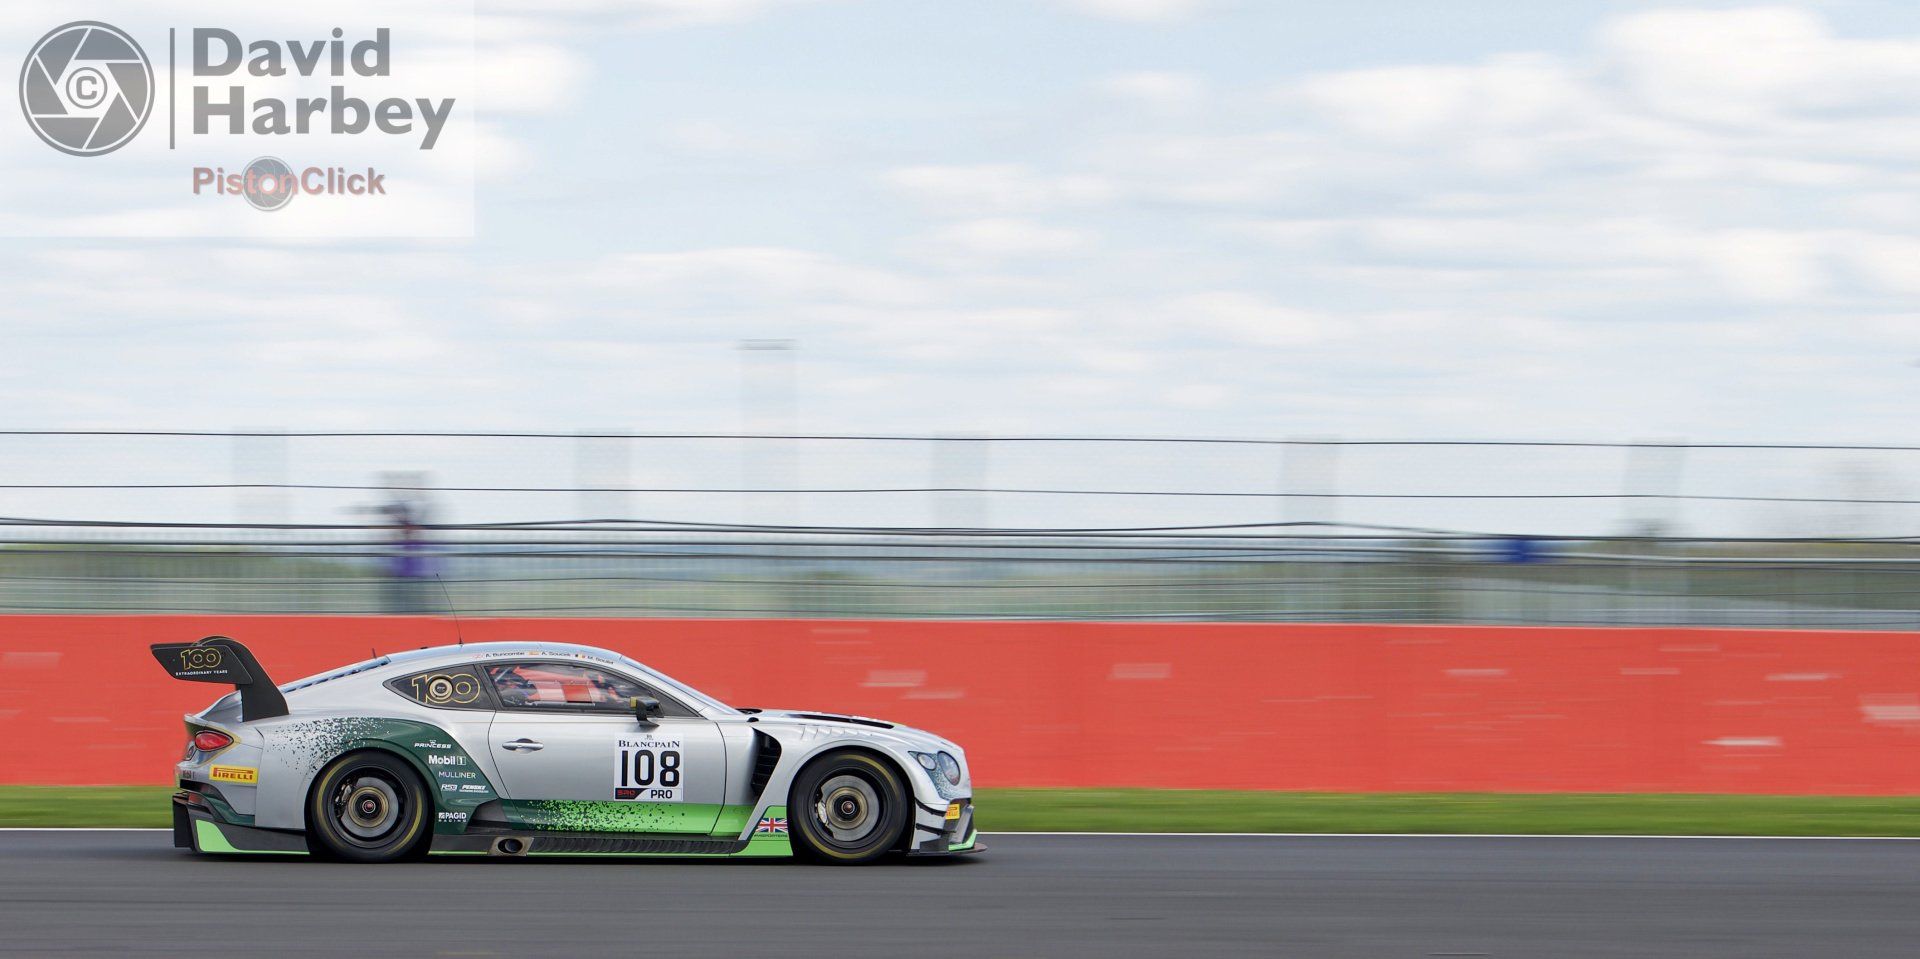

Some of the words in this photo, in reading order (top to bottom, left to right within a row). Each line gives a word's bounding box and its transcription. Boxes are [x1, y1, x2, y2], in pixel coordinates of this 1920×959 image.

[181, 647, 222, 670] 100
[412, 673, 480, 704] 100
[428, 755, 456, 765] Mobil
[213, 767, 253, 780] PIRELLI
[621, 750, 680, 787] 108
[438, 771, 477, 779] MULLINER
[650, 789, 673, 799] PRO
[445, 812, 467, 820] PAGID
